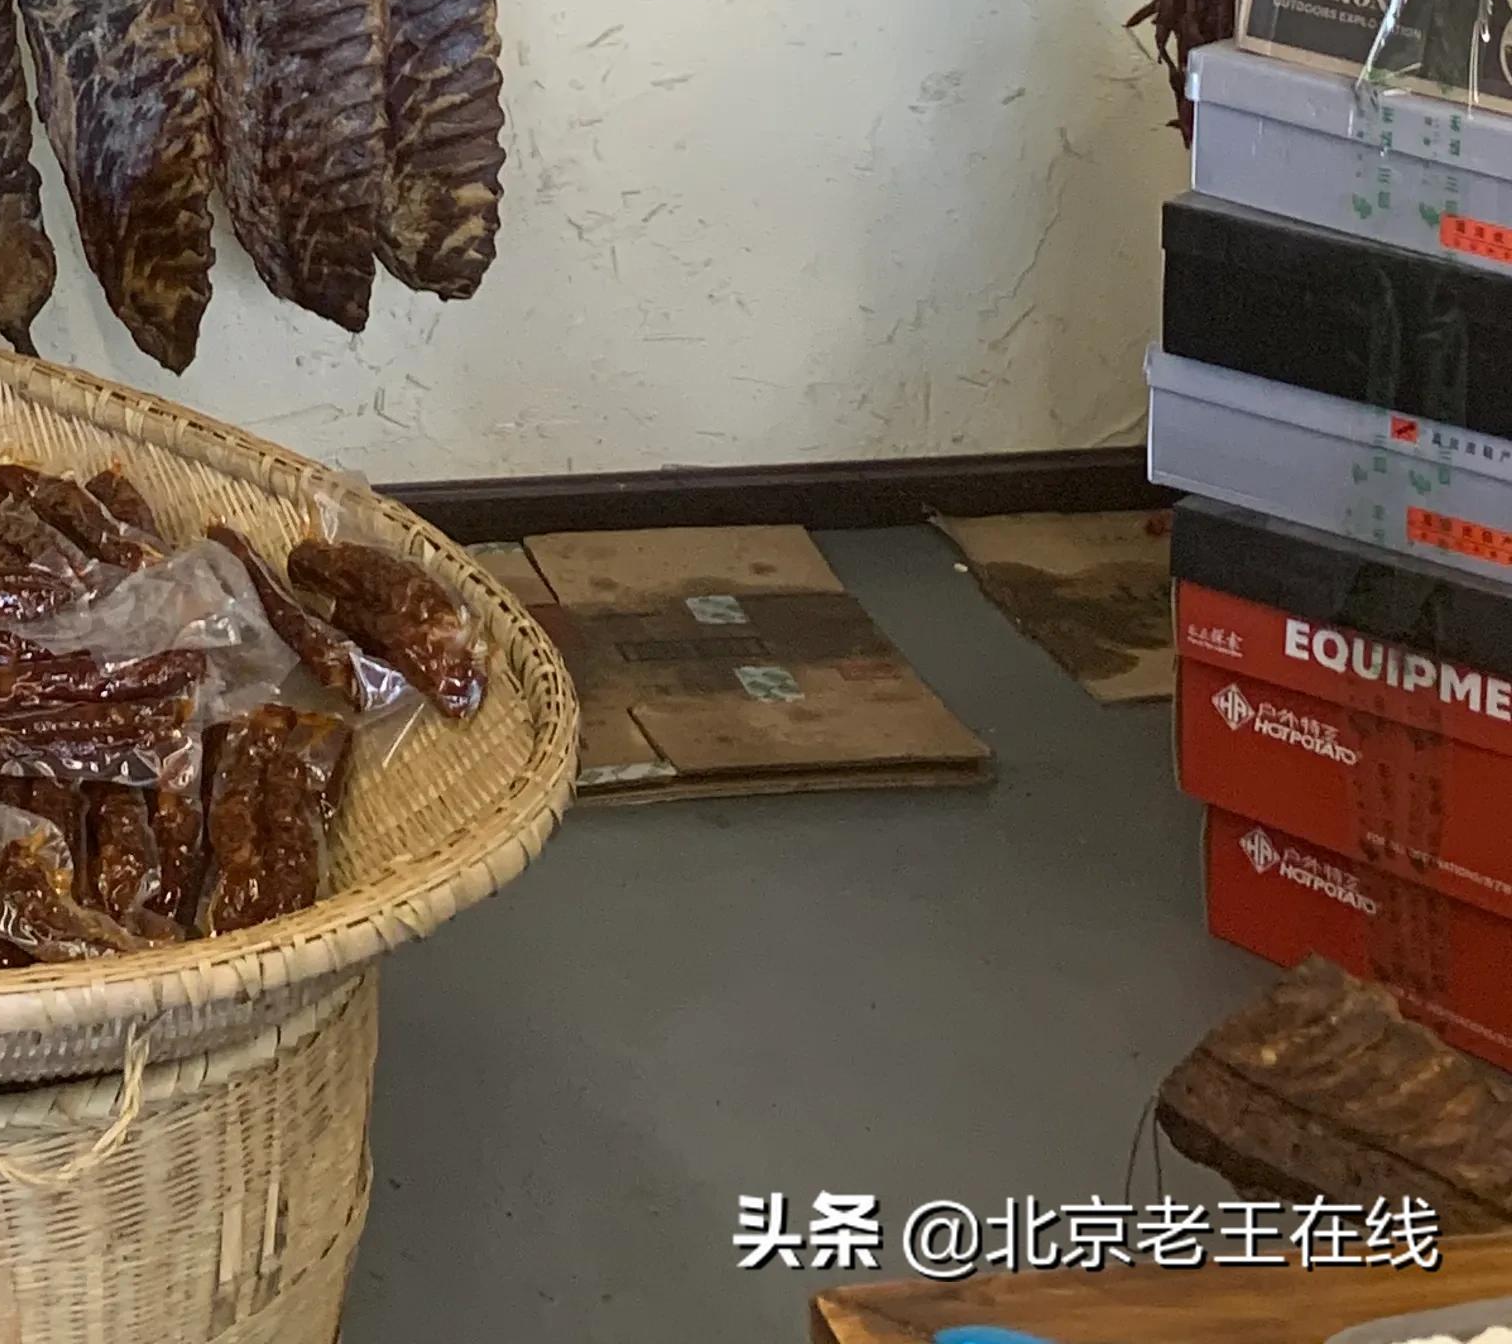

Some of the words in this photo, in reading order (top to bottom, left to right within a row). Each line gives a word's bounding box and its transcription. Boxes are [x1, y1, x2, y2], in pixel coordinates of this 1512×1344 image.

[1339, 11, 1422, 40] EXPLOTION
[1285, 618, 1512, 722] EQUIPME
[1254, 717, 1357, 765] HOTPOTATO
[1279, 862, 1376, 914] HOTPOTATO
